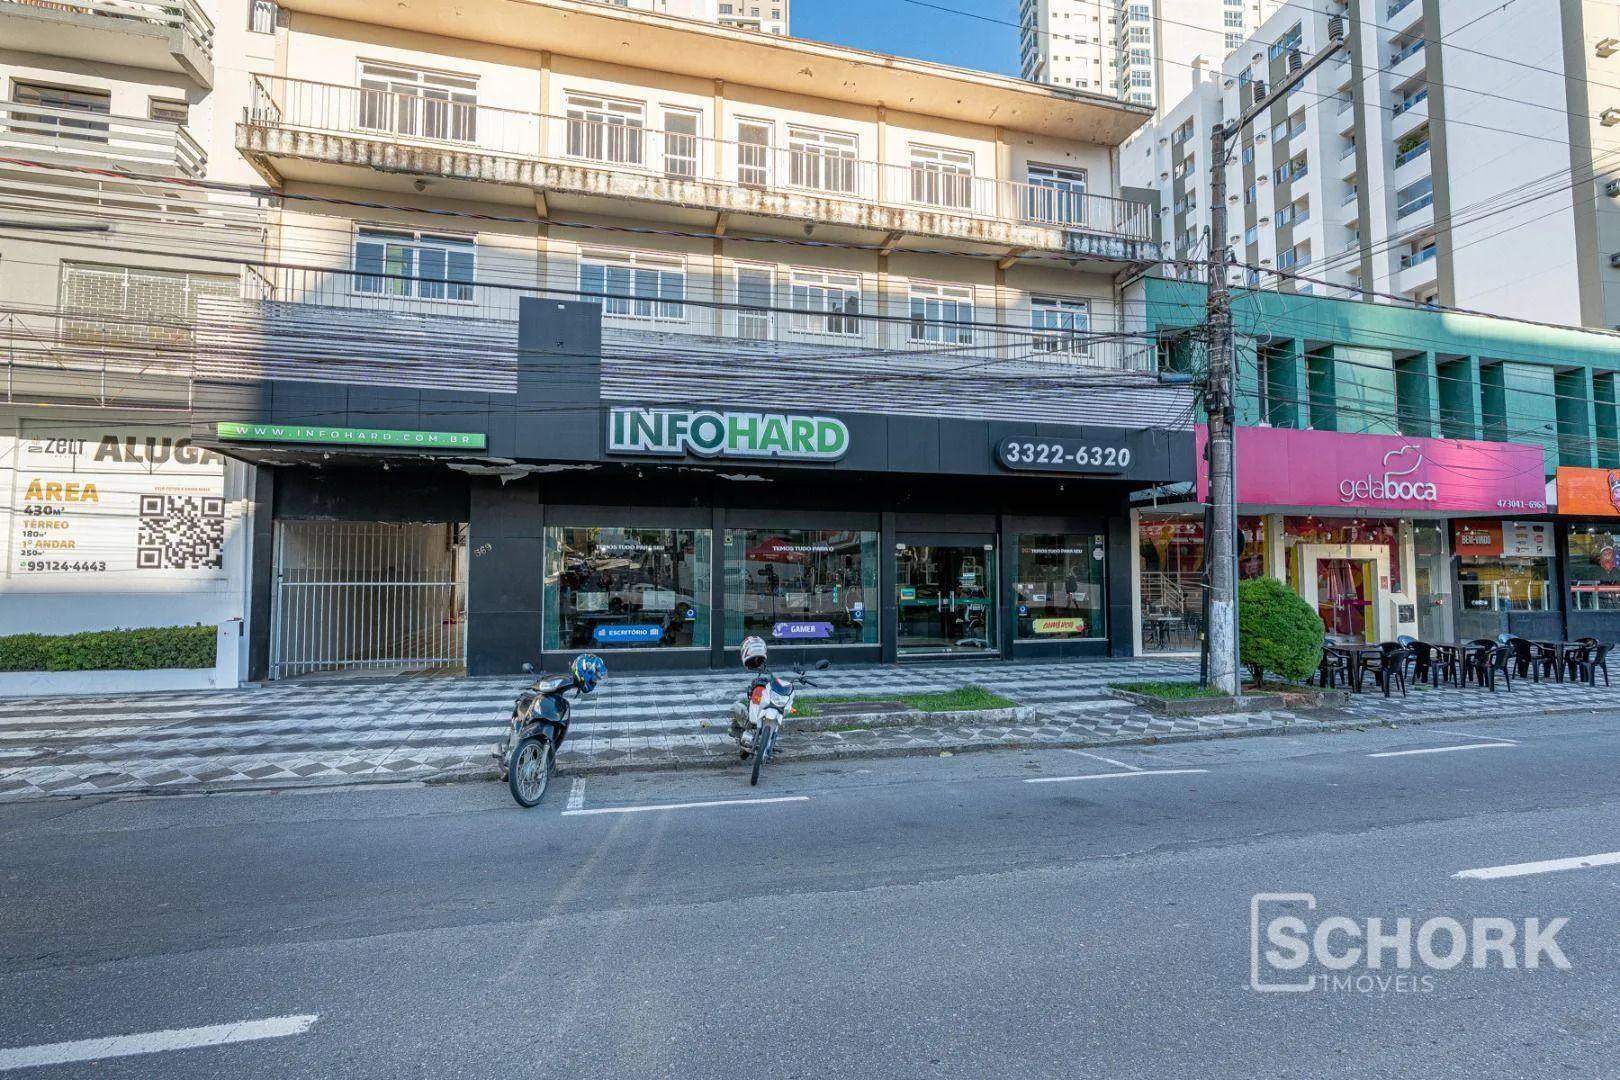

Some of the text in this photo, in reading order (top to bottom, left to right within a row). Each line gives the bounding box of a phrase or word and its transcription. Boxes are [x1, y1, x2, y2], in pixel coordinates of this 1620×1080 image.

[609, 407, 850, 460] INFOHARD
[1006, 442, 1131, 467] 3322-6320
[24, 478, 99, 503] ÁREA
[1339, 473, 1437, 502] gelaboca
[23, 519, 70, 529] TÉRREO
[34, 540, 76, 549] ANDAR
[27, 561, 106, 571] 99124-4443
[790, 625, 816, 633] GAMER
